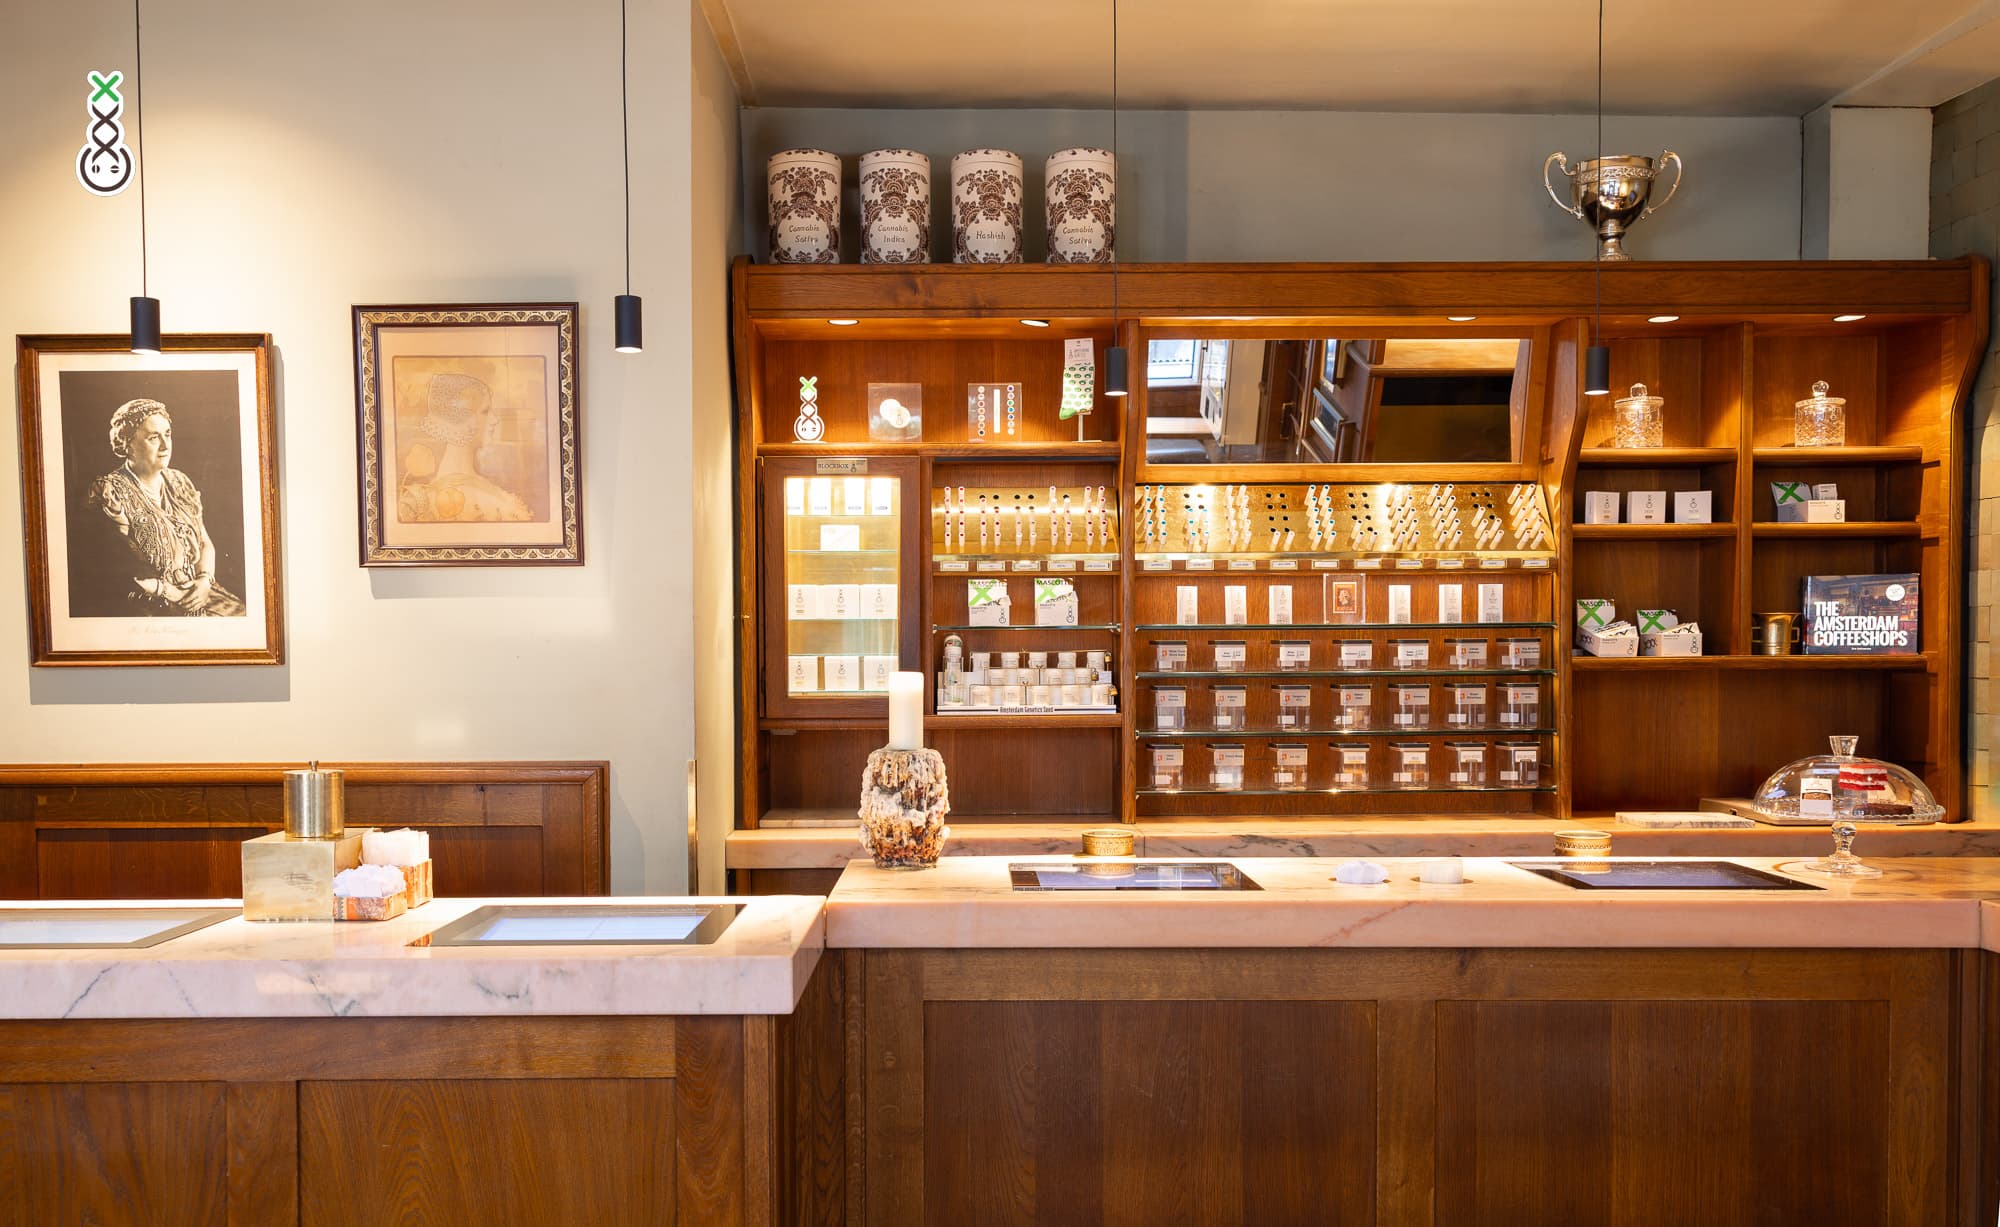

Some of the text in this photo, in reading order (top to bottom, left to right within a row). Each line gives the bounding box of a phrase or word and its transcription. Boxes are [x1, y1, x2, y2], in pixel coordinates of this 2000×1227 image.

[788, 225, 820, 233] Cannabis
[877, 224, 909, 232] Cannabis
[1062, 226, 1094, 234] Cannabis
[883, 235, 905, 243] Indica
[976, 231, 1006, 240] Hashish
[1814, 601, 1840, 617] THE
[1813, 616, 1899, 631] AMSTERDAM
[1813, 630, 1908, 647] COFFEESHOPS
